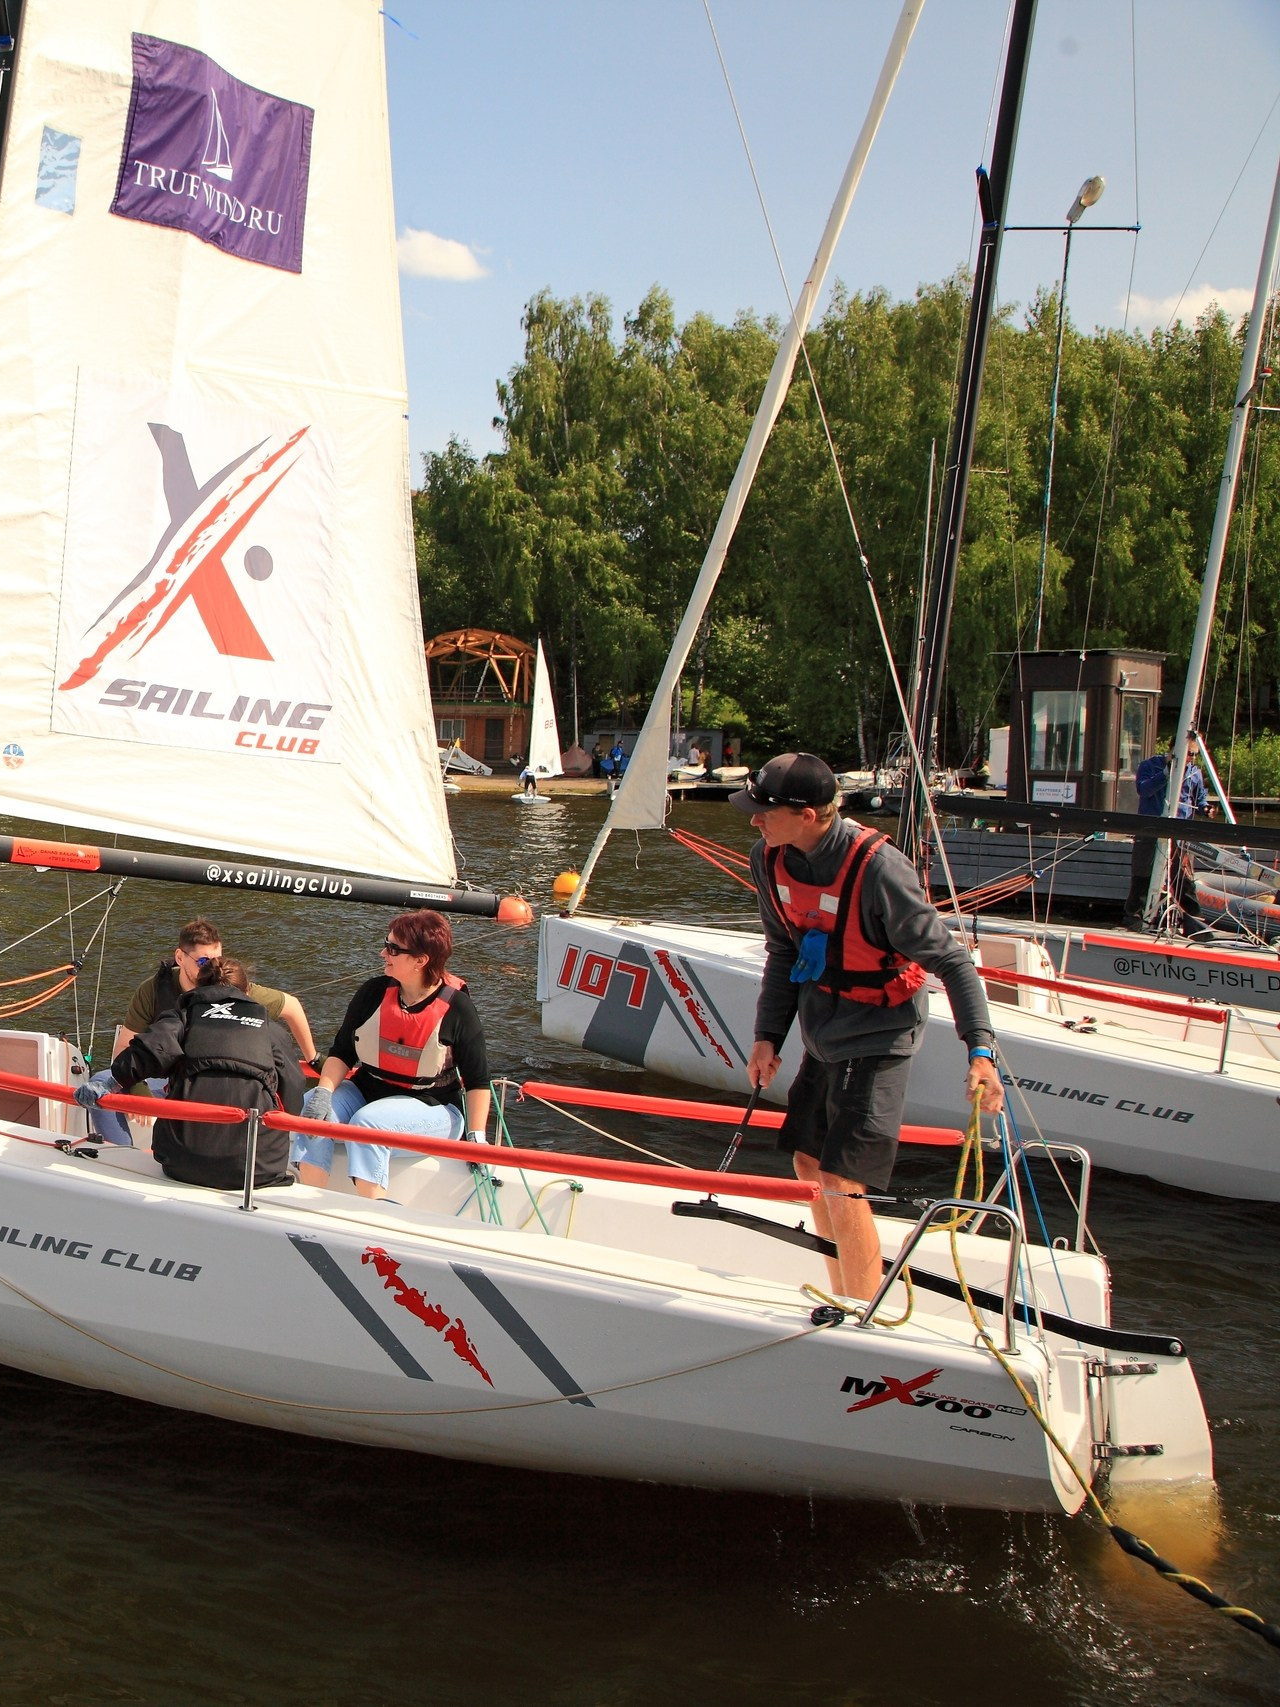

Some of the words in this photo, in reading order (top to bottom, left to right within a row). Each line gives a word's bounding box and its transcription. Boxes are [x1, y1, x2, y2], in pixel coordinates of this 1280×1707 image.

[133, 159, 284, 235] TRUEWIND.RU
[98, 678, 333, 731] SAILING
[234, 731, 320, 755] CLUB
[206, 864, 353, 896] @xsailingclub
[557, 943, 651, 1011] 107
[1002, 1074, 1109, 1106] SAILING
[1115, 1099, 1195, 1124] CLUB
[100, 1248, 203, 1282] CLUB
[917, 1390, 957, 1401] SAILING
[960, 1398, 996, 1409] BOATS
[949, 1425, 1016, 1442] CARBON
